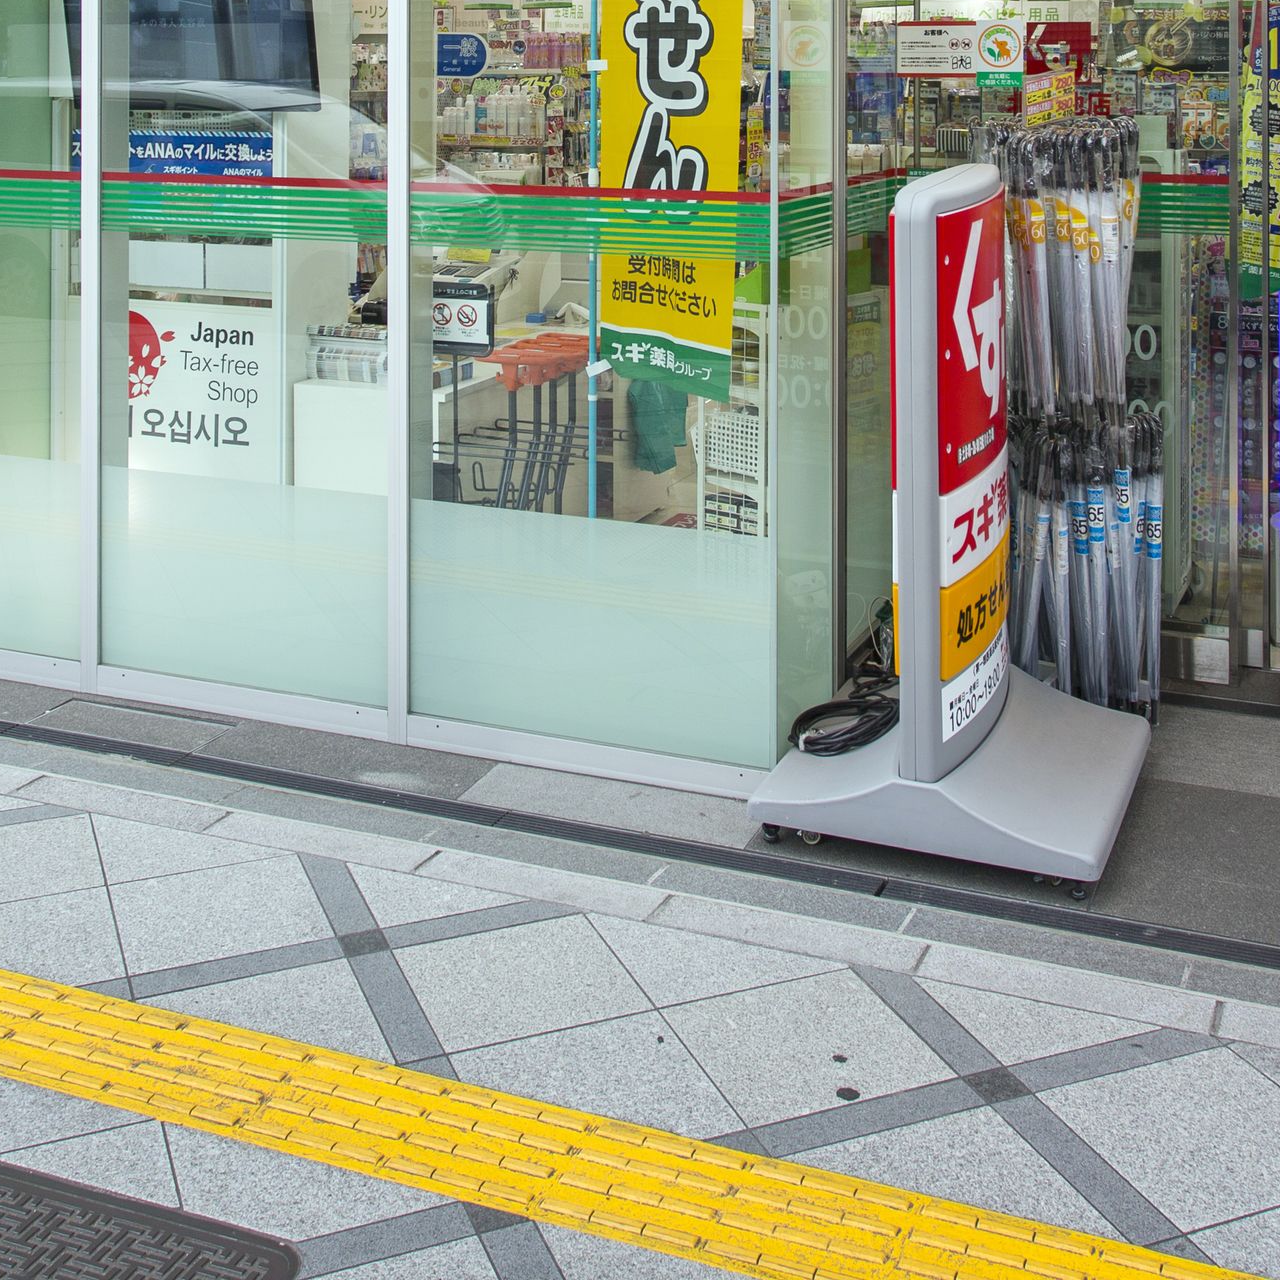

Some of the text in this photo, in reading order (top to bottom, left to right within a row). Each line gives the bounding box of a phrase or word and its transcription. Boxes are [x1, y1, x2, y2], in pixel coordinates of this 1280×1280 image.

[924, 29, 950, 37] お客様へ
[443, 37, 479, 58] 一般
[988, 72, 1011, 80] お気軽に
[1031, 224, 1045, 240] 60
[1056, 224, 1070, 239] 60
[1073, 231, 1088, 247] 60
[627, 254, 697, 286] 受付時間は
[610, 281, 718, 319] お問合せください
[190, 321, 254, 348] Japan
[180, 350, 259, 376] Tax-free
[207, 380, 258, 408] Shop
[1116, 488, 1129, 504] 65
[1088, 507, 1104, 522] 65
[1072, 518, 1088, 535] 65
[1146, 523, 1162, 539] 65
